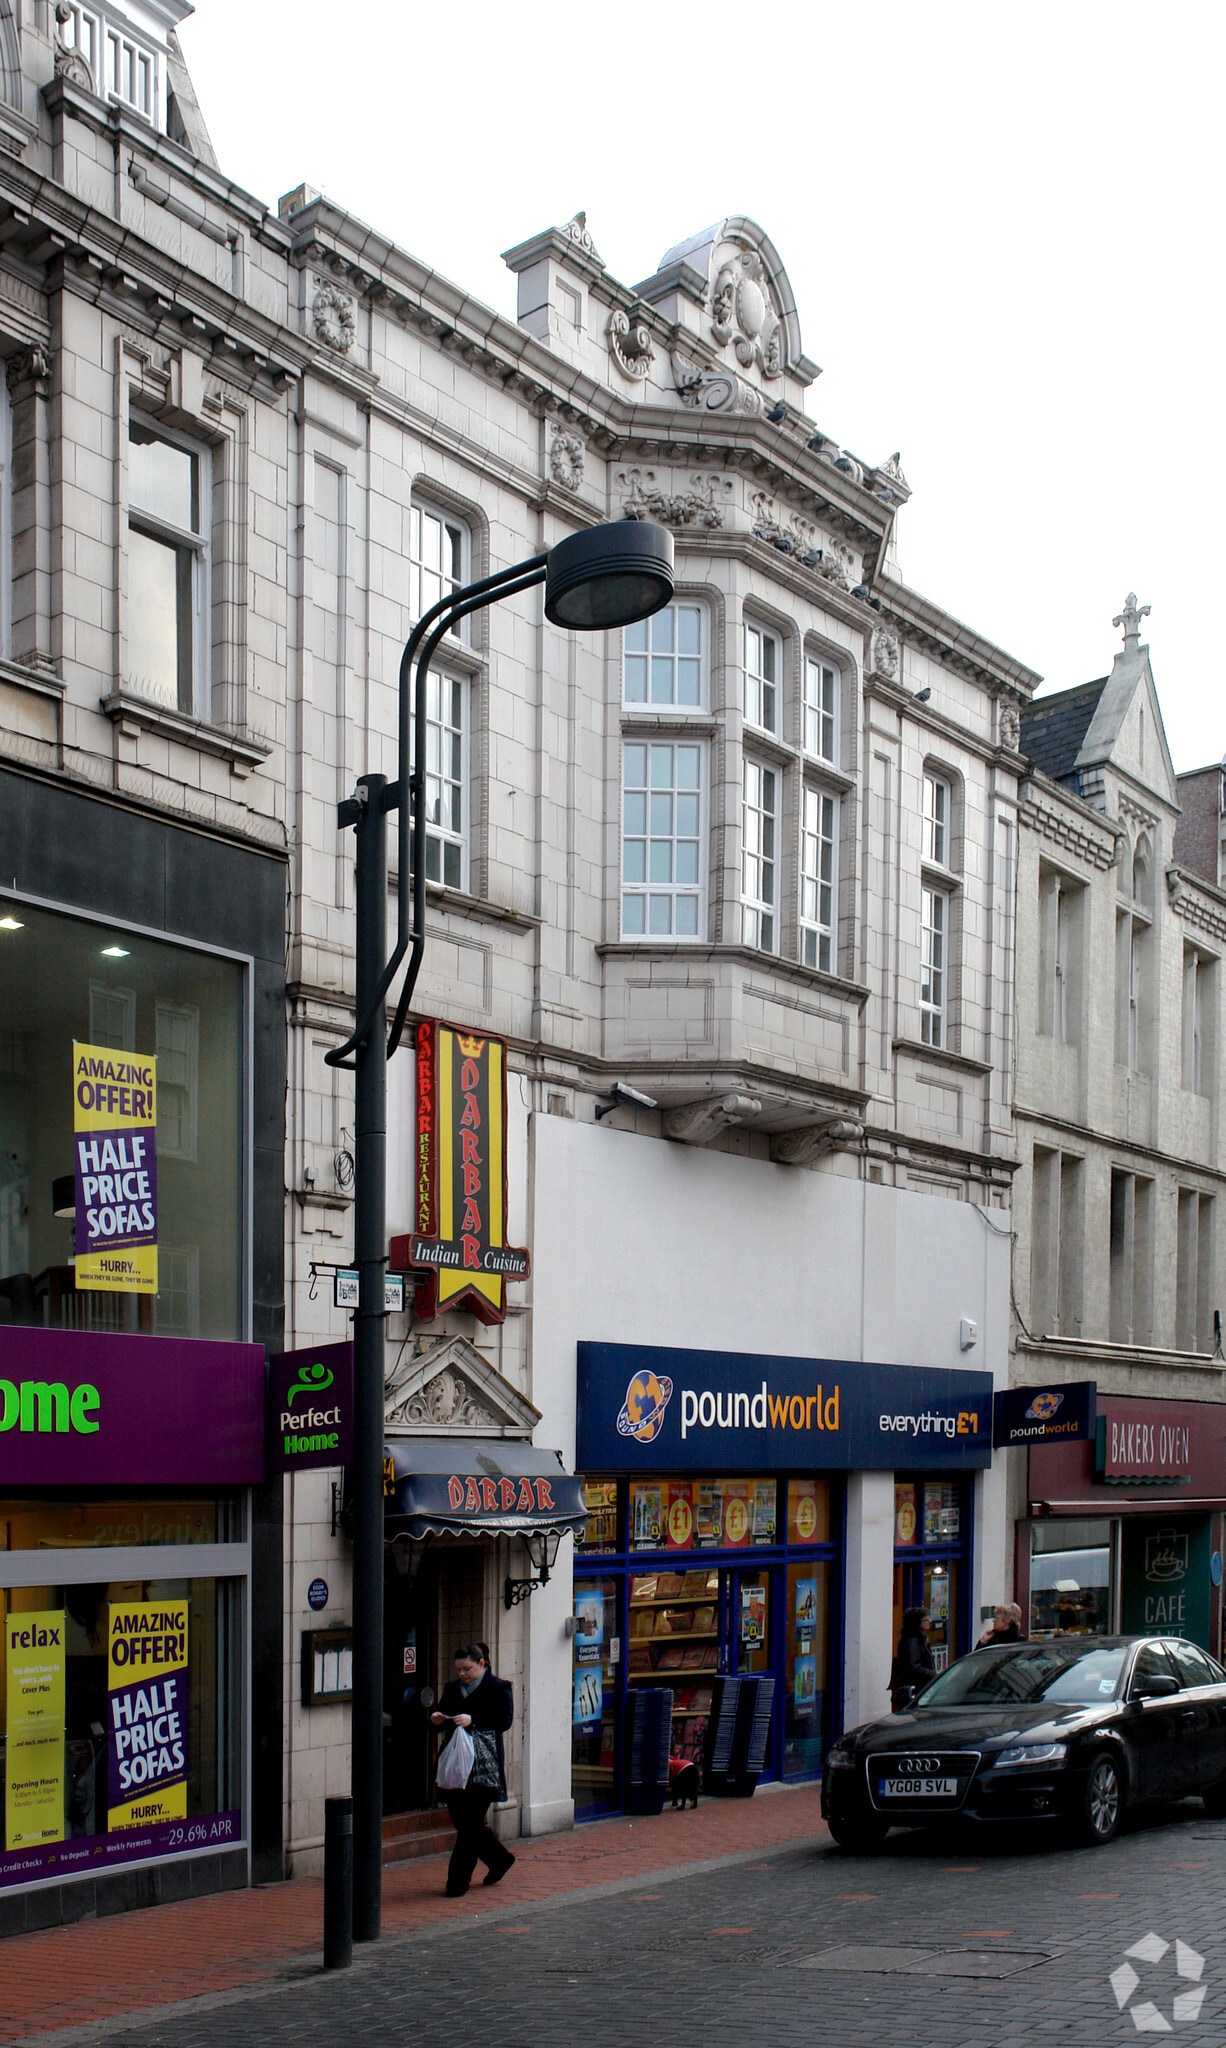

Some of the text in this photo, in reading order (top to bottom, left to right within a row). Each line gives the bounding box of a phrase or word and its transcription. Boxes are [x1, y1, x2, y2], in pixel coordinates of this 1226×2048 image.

[77, 1056, 152, 1087] AMAZING
[418, 1023, 432, 1133] DARBAR
[77, 1080, 153, 1120] OFFER!
[78, 1136, 146, 1173] HALF
[459, 1058, 483, 1269] DARBAR
[82, 1171, 152, 1206] PRICE
[418, 1133, 431, 1233] RESTAURANT
[86, 1202, 155, 1237] SOFAS
[100, 1260, 141, 1274] HURRY...
[414, 1242, 526, 1273] Indian Cuisine
[280, 1406, 342, 1431] Perfect
[680, 1381, 840, 1439] poundworld
[284, 1432, 339, 1454] Home
[1010, 1421, 1079, 1440] poundworld
[1111, 1422, 1189, 1465] BAKERS OVEN
[447, 1475, 556, 1514] DARBAR
[673, 1507, 688, 1531] £1
[730, 1506, 744, 1529] £1
[800, 1504, 813, 1525] £1
[902, 1509, 913, 1529] £1
[1145, 1589, 1186, 1624] CAFÉ
[11, 1623, 61, 1649] relax
[112, 1612, 185, 1634] AMAZING
[112, 1633, 185, 1666] OFFER!
[579, 1646, 599, 1655] Everyday
[22, 1685, 51, 1695] Cover Plus
[111, 1679, 177, 1729] HALF
[115, 1712, 182, 1760] PRICE
[118, 1741, 185, 1789] SOFAS
[11, 1778, 59, 1791] Opening Hours
[887, 1780, 952, 1793] YG08 SVL
[131, 1803, 170, 1820] HURRY...
[3, 1861, 21, 1873] Credit
[22, 1858, 43, 1869] Checks
[68, 1850, 90, 1861] Deposit
[106, 1843, 126, 1852] Weekly
[126, 1838, 152, 1849] Payments
[168, 1824, 207, 1846] 29.6%
[210, 1819, 232, 1838] APR
